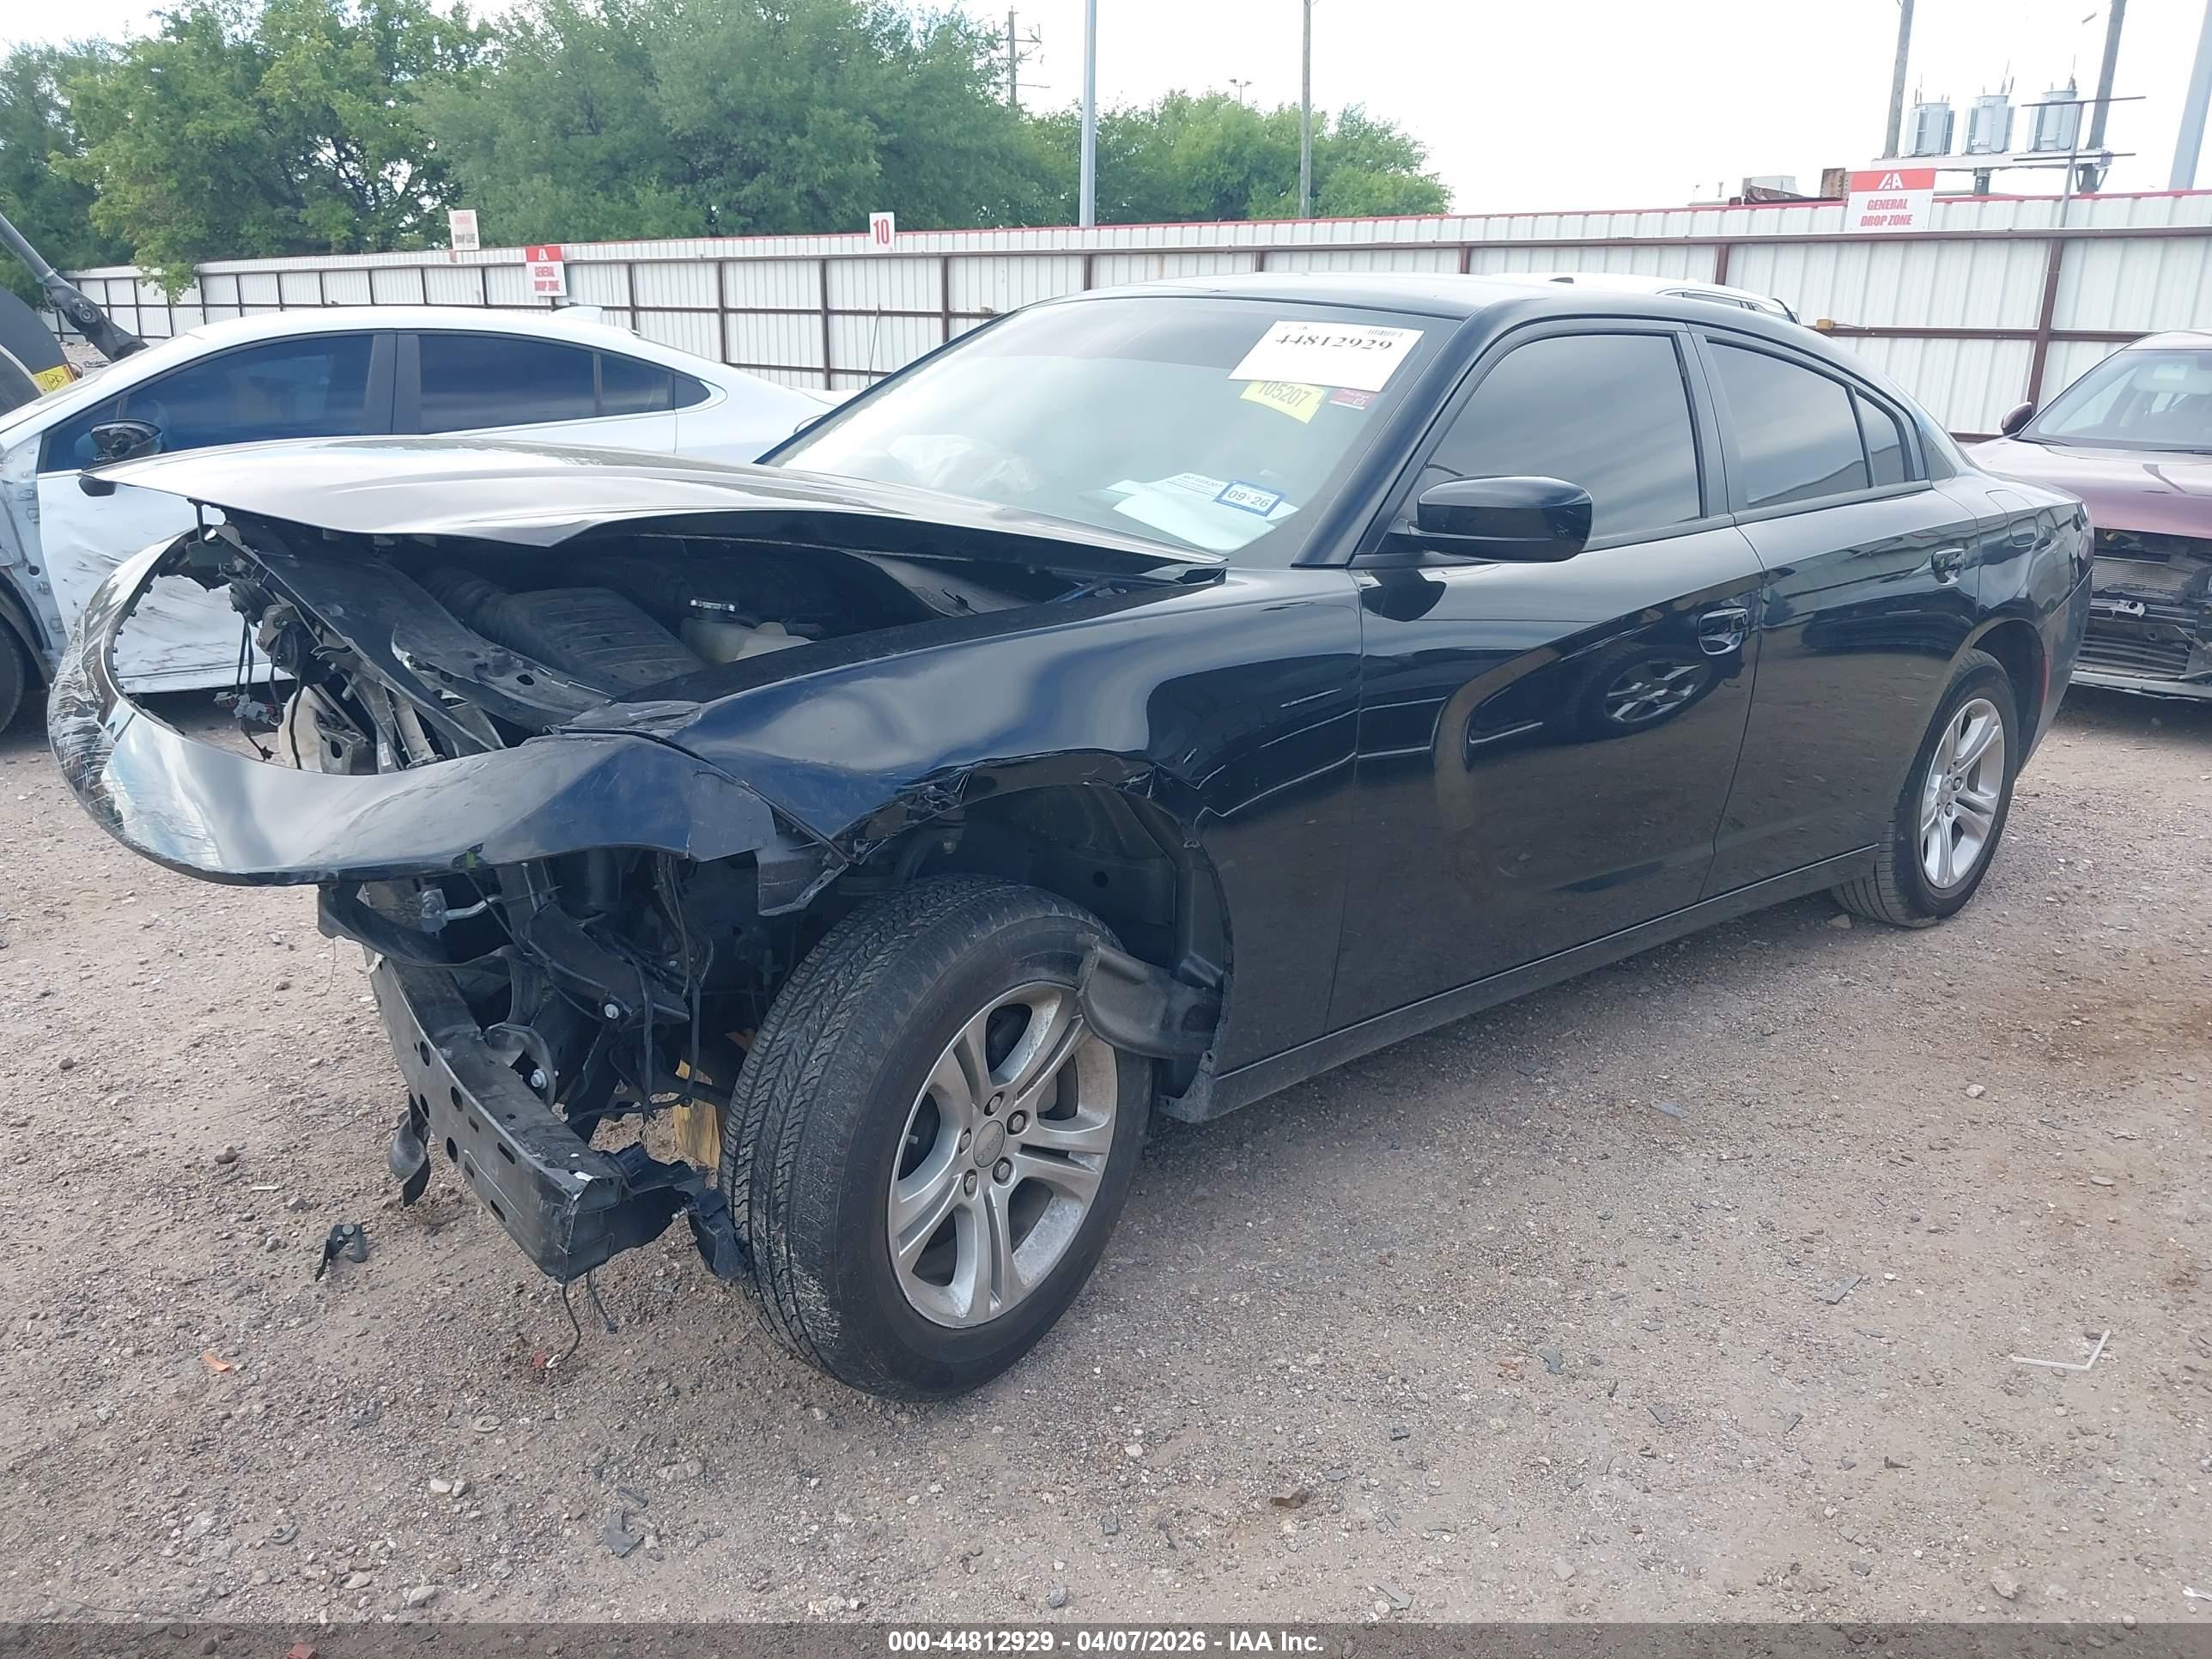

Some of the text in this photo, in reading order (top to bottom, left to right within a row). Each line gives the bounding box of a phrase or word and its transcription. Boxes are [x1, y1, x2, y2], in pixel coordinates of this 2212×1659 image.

[1867, 198, 1908, 210] GENERAL
[1860, 214, 1913, 227] DROP ZONE
[873, 219, 890, 245] 10
[1275, 333, 1393, 350] 44812929
[1228, 489, 1271, 507] 09 26
